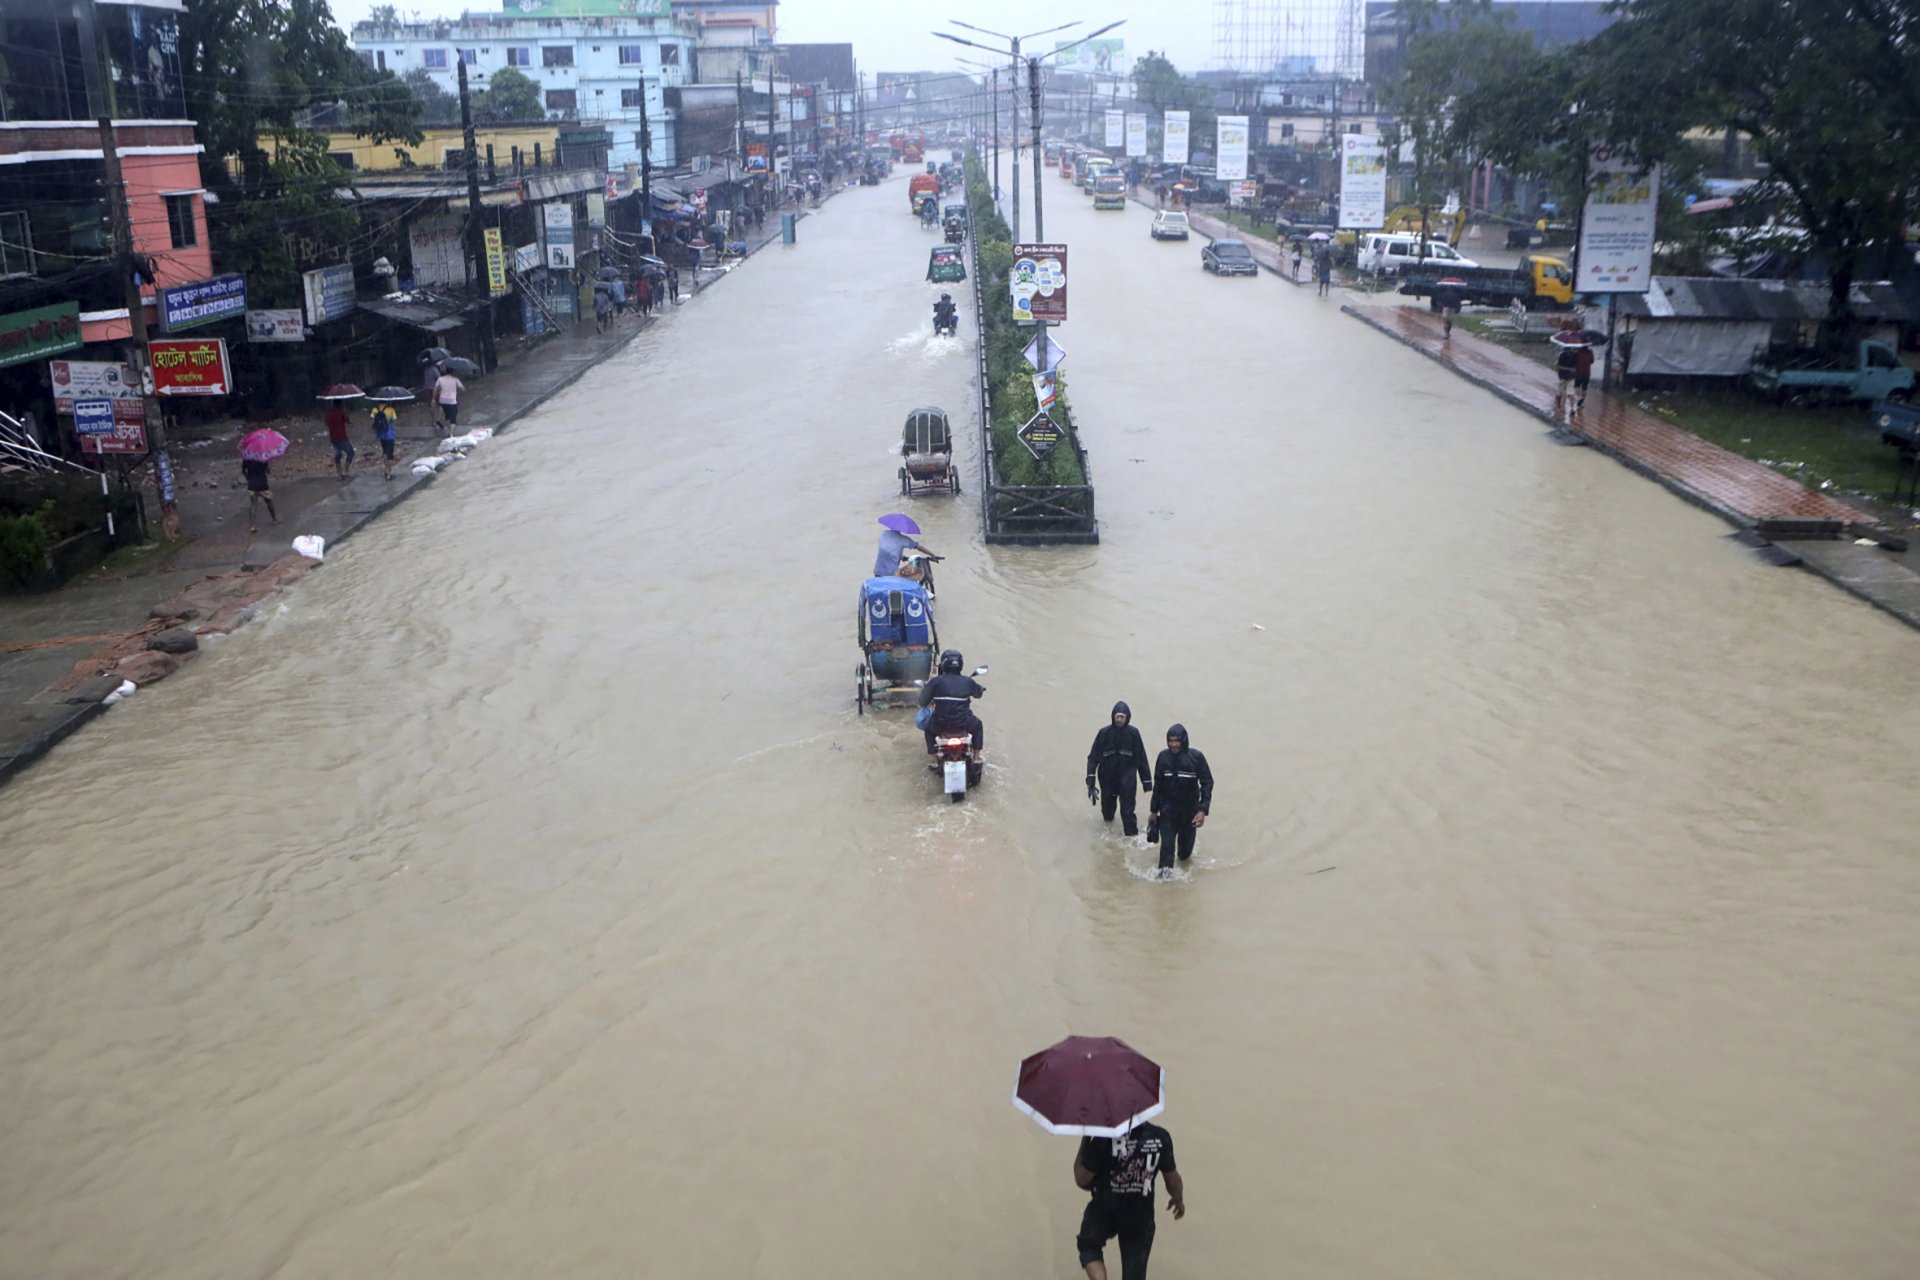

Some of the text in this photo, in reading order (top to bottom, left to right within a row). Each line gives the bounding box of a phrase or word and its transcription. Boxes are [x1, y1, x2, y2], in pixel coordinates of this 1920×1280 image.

[153, 344, 218, 369] হোটেল মার্টিন
[174, 372, 203, 383] আবাসিক
